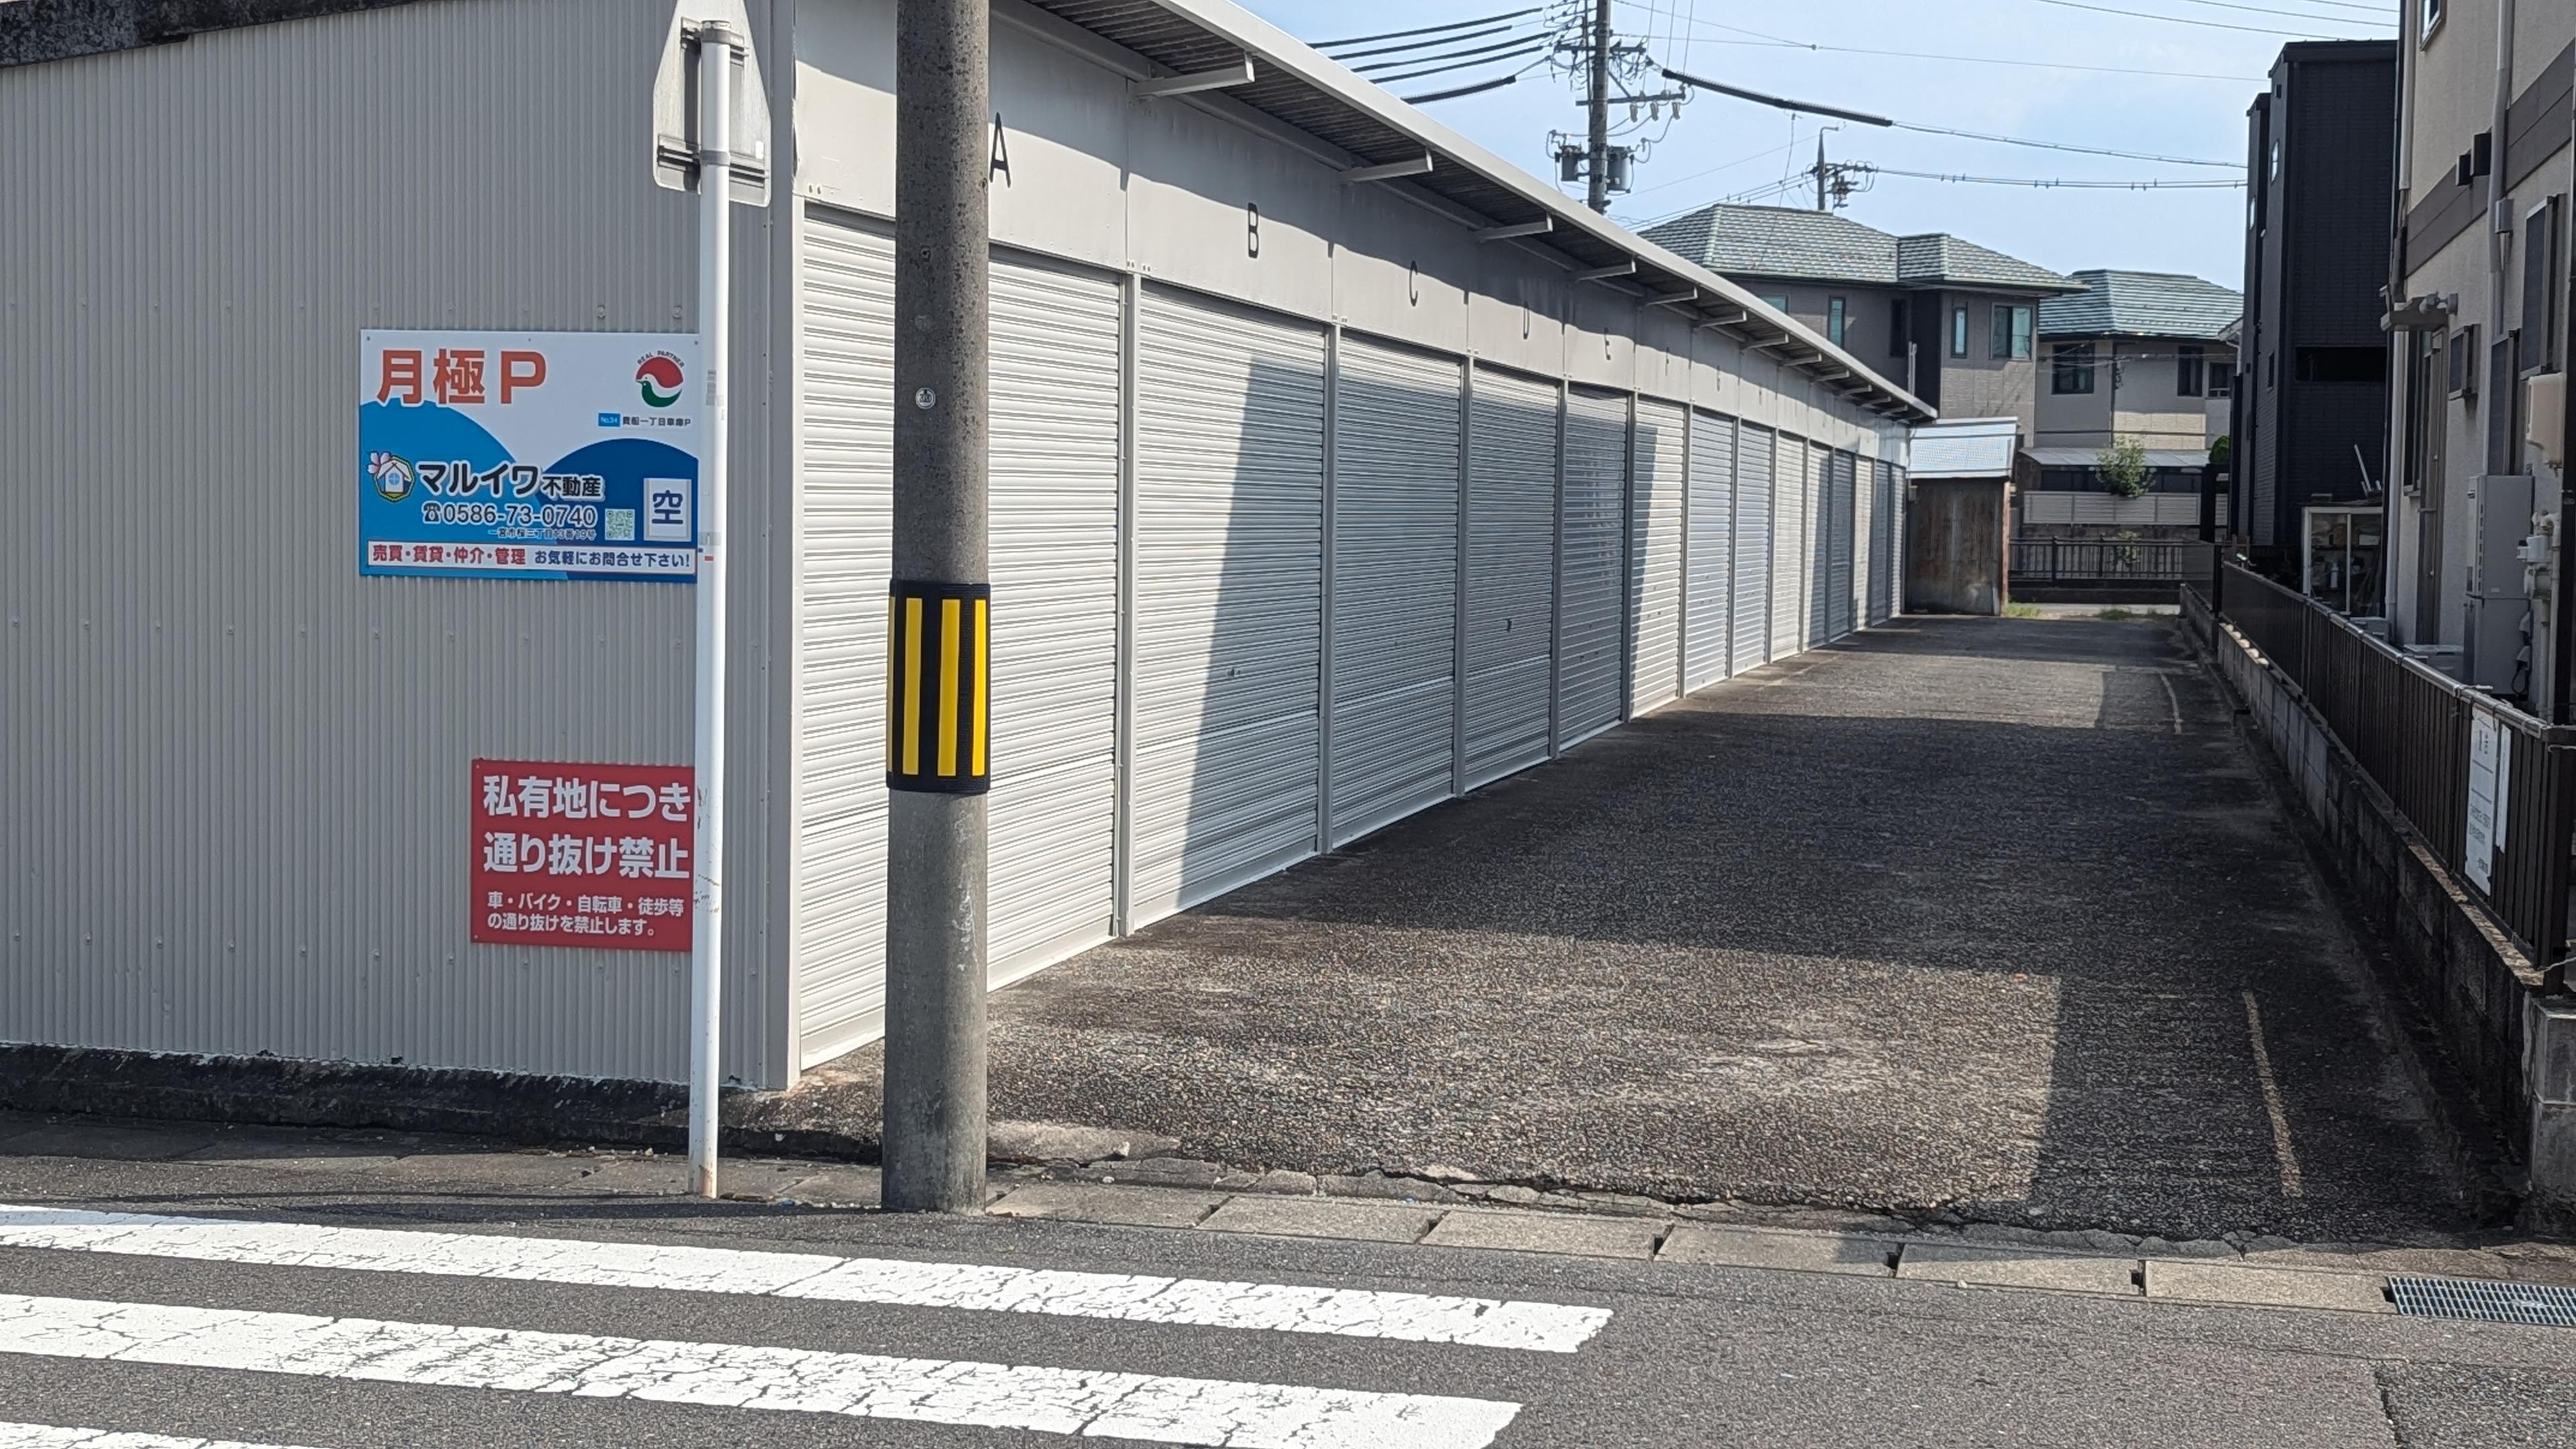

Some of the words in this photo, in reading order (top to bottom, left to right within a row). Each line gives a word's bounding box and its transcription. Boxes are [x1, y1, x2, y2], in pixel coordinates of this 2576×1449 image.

[989, 112, 1011, 189] A
[1248, 203, 1259, 259] B
[1409, 260, 1418, 307] C
[376, 348, 546, 404] 月極P
[637, 352, 653, 365] REAL
[657, 350, 685, 368] PARTNER
[418, 463, 601, 496] マルイワ不動産
[444, 504, 596, 526] 0586-73-0740
[652, 489, 683, 525] 空
[373, 545, 526, 565] 売買・賃貸・仲介・管理
[483, 775, 691, 822] 私有地につき
[483, 832, 690, 879] 通り抜け禁止
[487, 891, 684, 917] 車・バイク・自転車・徒歩等
[487, 912, 655, 936] の通り抜けを禁止します。
